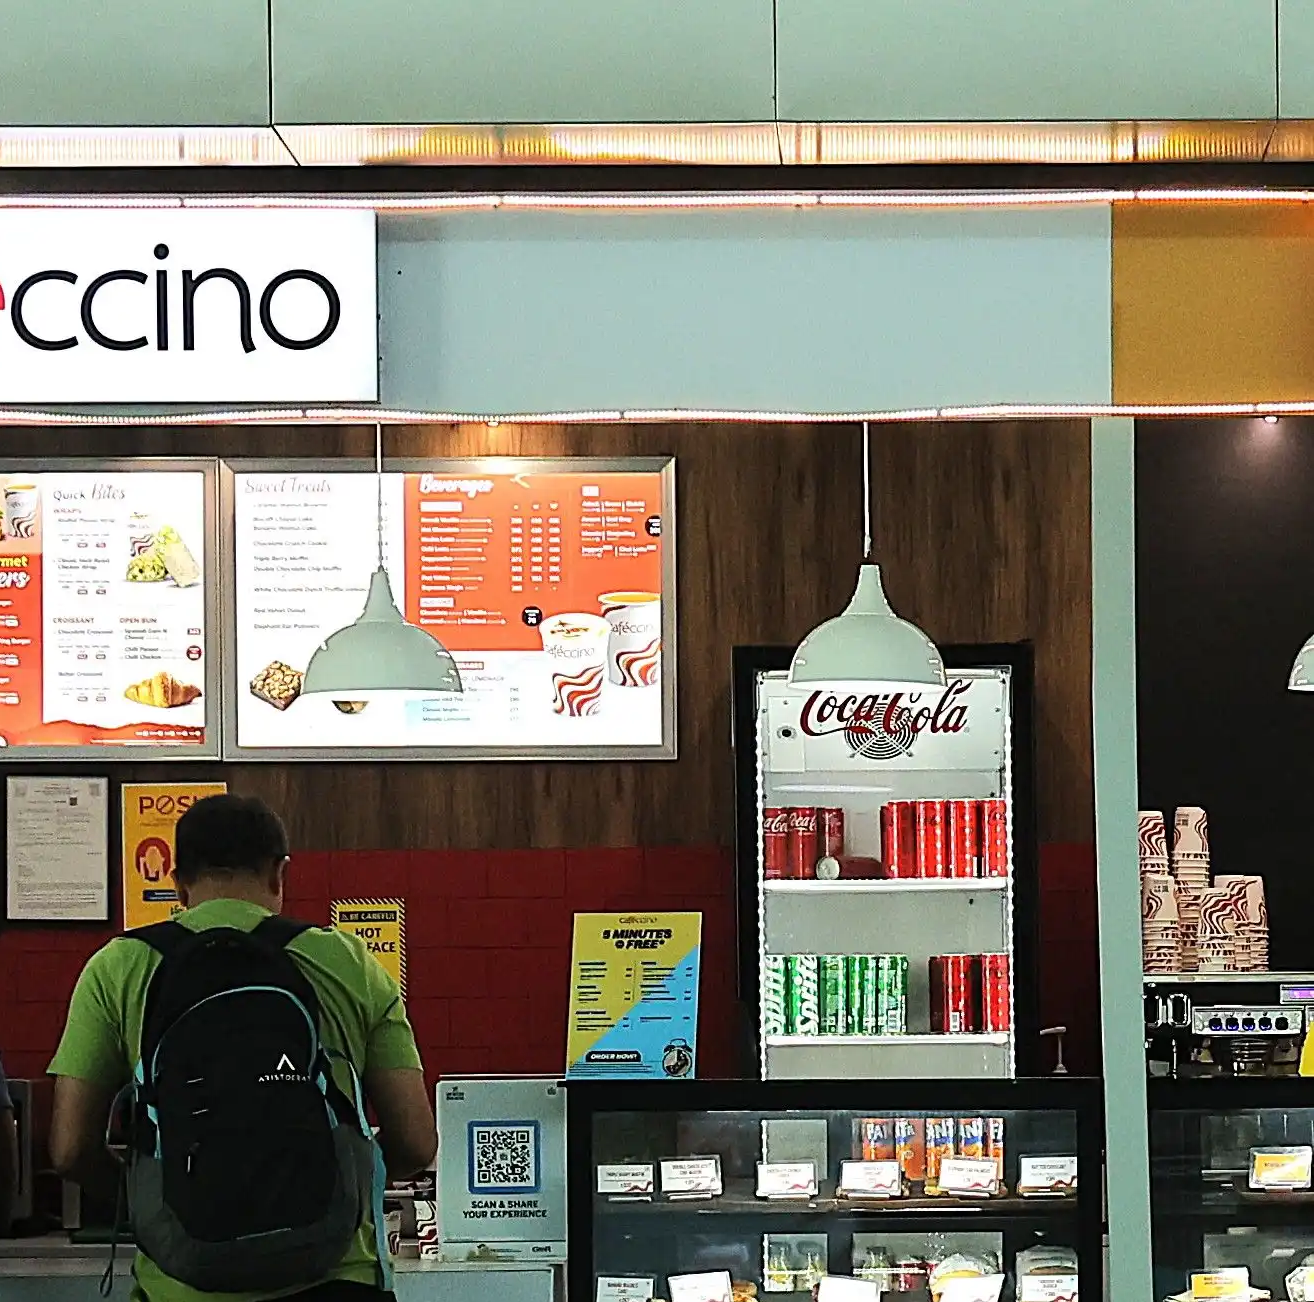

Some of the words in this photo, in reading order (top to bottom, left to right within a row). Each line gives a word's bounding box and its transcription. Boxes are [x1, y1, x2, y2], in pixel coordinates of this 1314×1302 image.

[53, 490, 86, 501] Quick
[355, 928, 382, 938] HOT
[612, 929, 673, 940] MINUTES
[366, 941, 397, 953] FACE
[471, 1200, 497, 1209] SCAN
[498, 1200, 507, 1208] &
[508, 1200, 538, 1208] SHARE
[463, 1210, 488, 1219] YOUR
[489, 1210, 547, 1219] EXPERIENCE
